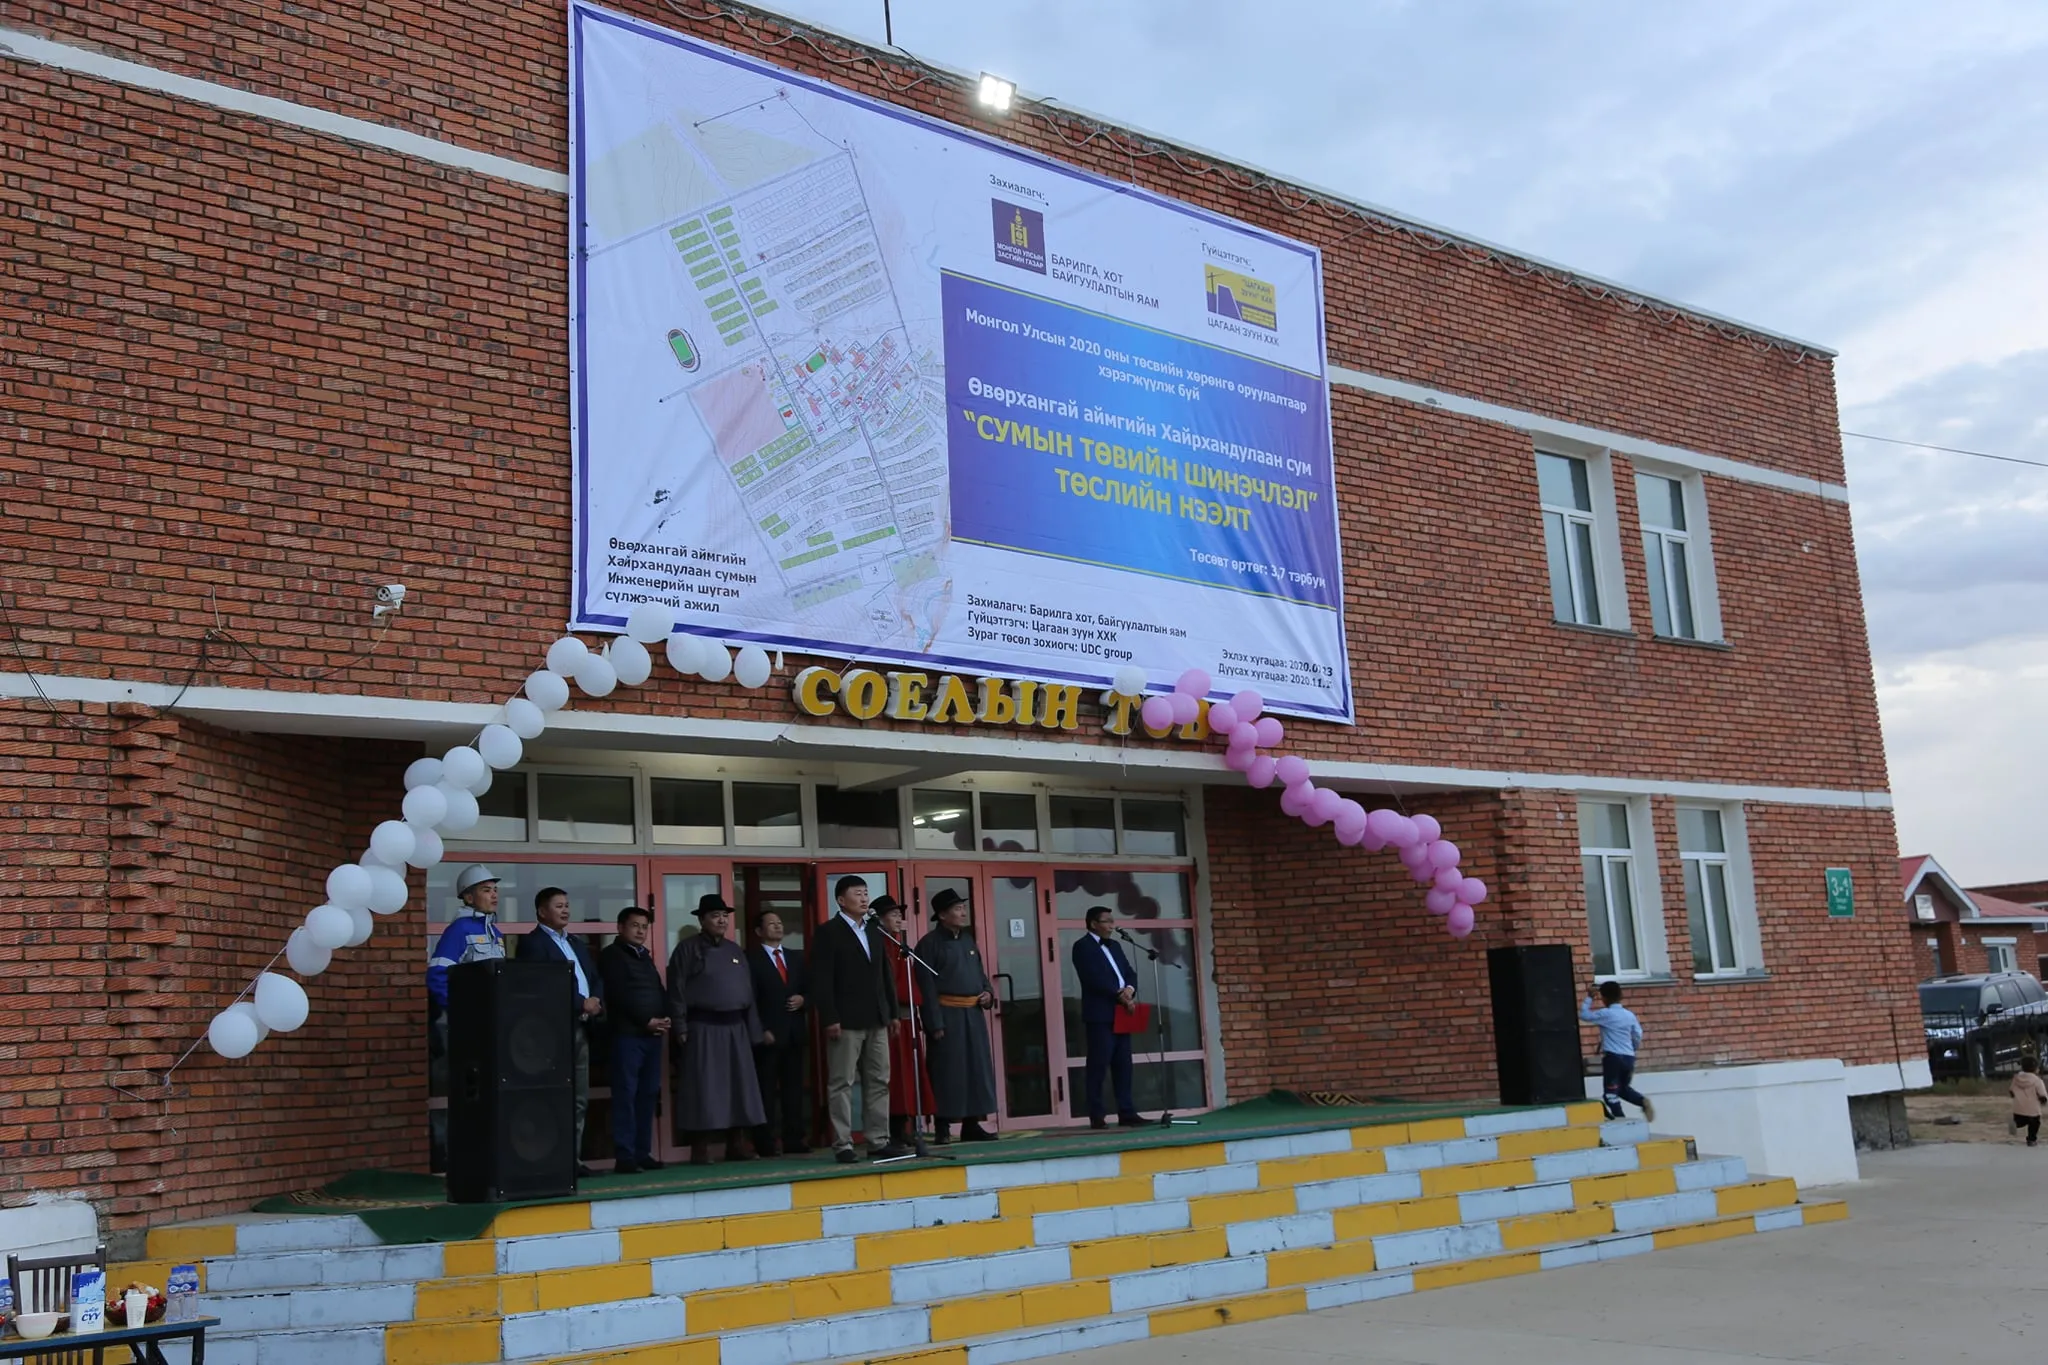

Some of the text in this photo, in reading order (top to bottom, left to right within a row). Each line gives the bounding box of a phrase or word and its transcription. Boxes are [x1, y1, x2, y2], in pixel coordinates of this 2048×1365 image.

[989, 174, 1045, 200] Захиалагч:
[997, 242, 1044, 261] МОНГОЛ УЛСЫН
[997, 250, 1044, 269] ЗАСГИЙН ГАЗАР
[1051, 253, 1124, 284] БАРИЛГА, ХОТ
[1052, 268, 1160, 308] БАЙГУУЛАЛТЫН ЯАМ
[1207, 316, 1241, 336] ЦАГААН
[1263, 334, 1280, 347] ХХК
[965, 307, 1308, 414] Монгол Улсын 2020 оны төсвийн хөрөнгө оруулалтаар
[1098, 364, 1176, 395] хэрэгжүүлж
[968, 376, 1313, 477] Өвөрхангай аймгийн Хайрхандулаан сум
[1079, 436, 1178, 481] ТӨВИЙН
[1054, 466, 1253, 532] ТӨСЛИЙН НЭЭЛТ
[609, 536, 747, 566] Өвөрхангай аймгийн
[1189, 548, 1229, 569] Төсөвт
[1231, 559, 1269, 576] өртөг:
[1271, 564, 1286, 582] 3,7
[607, 554, 757, 584] Хайрхандулаан сумын
[607, 572, 740, 599] Инженерийн шугам
[684, 599, 720, 613] ажил
[967, 594, 1188, 639] Захиалагч: Барилга хот, байгуулалтын яам
[967, 610, 1029, 630] Гүйцэтгэгч:
[1031, 619, 1069, 636] Цагаан
[1096, 629, 1118, 642] ХХК
[967, 626, 1134, 661] Зураг төсөл зохиогч: UDC group
[1222, 648, 1249, 663] Эхлэх
[1250, 655, 1288, 669] хугацаа:
[1218, 662, 1249, 677] Дуусах
[1251, 669, 1289, 683] хугацаа:
[796, 666, 1210, 740] СОЕЛЫН ТВ
